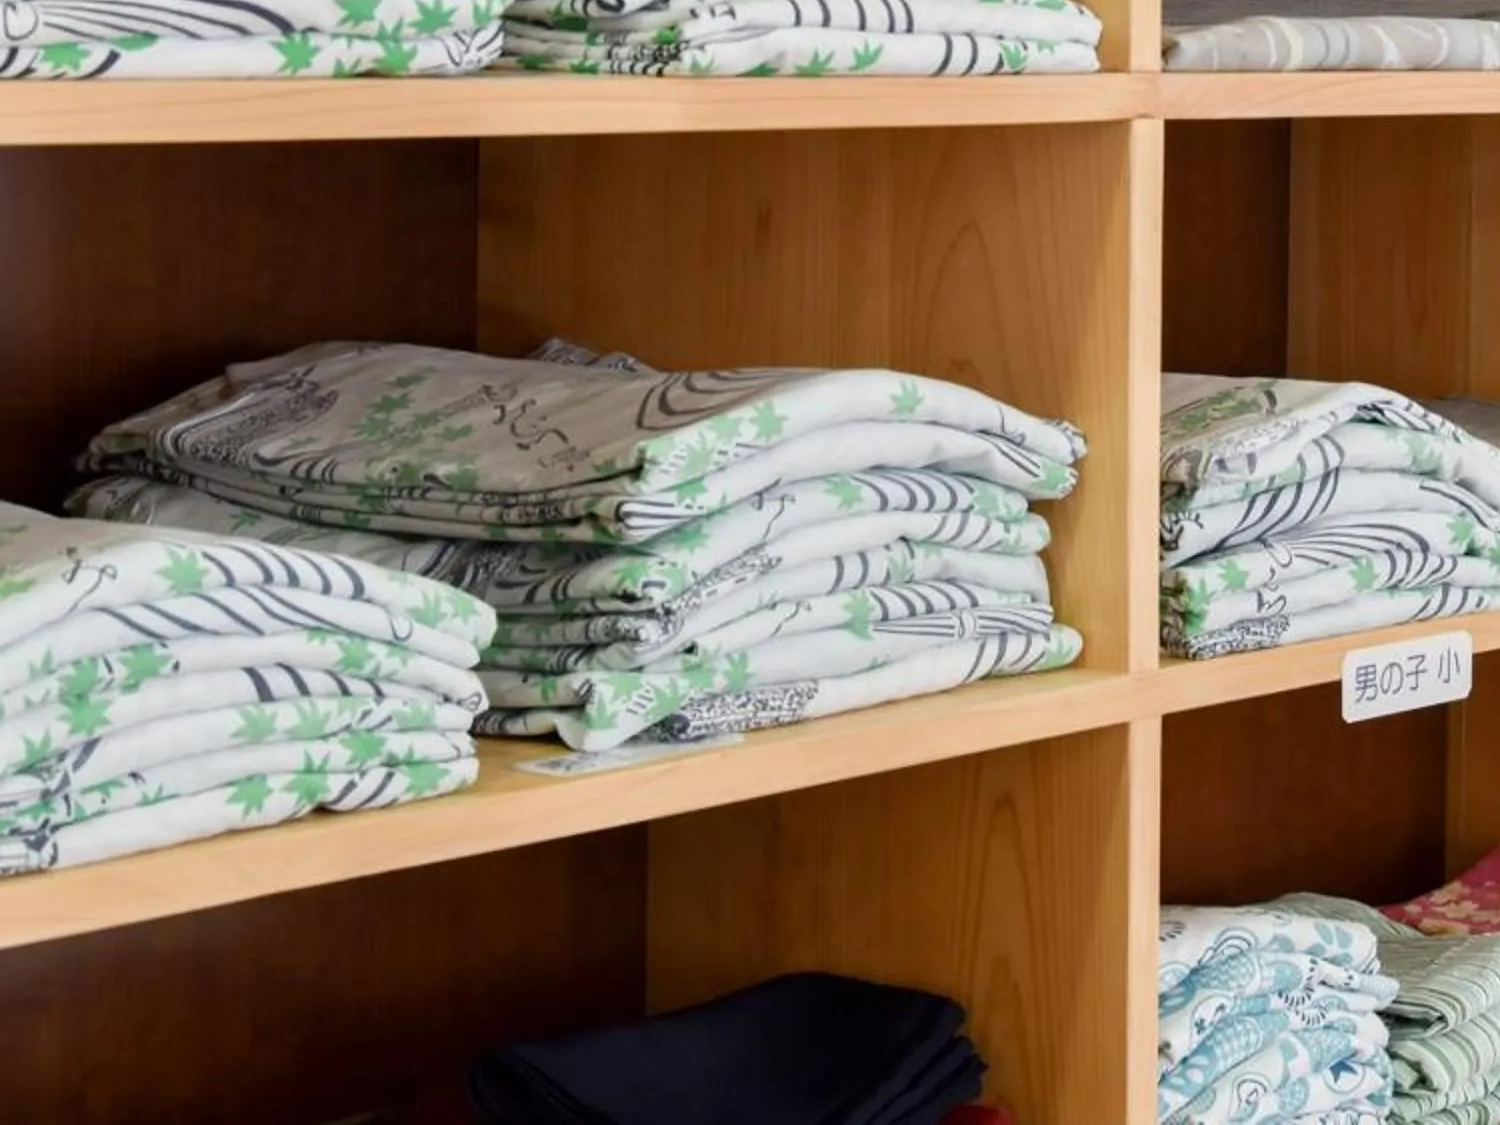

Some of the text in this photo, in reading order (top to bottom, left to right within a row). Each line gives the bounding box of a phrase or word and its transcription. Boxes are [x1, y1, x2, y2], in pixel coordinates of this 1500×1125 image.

[1355, 646, 1461, 704] 男の子 小
